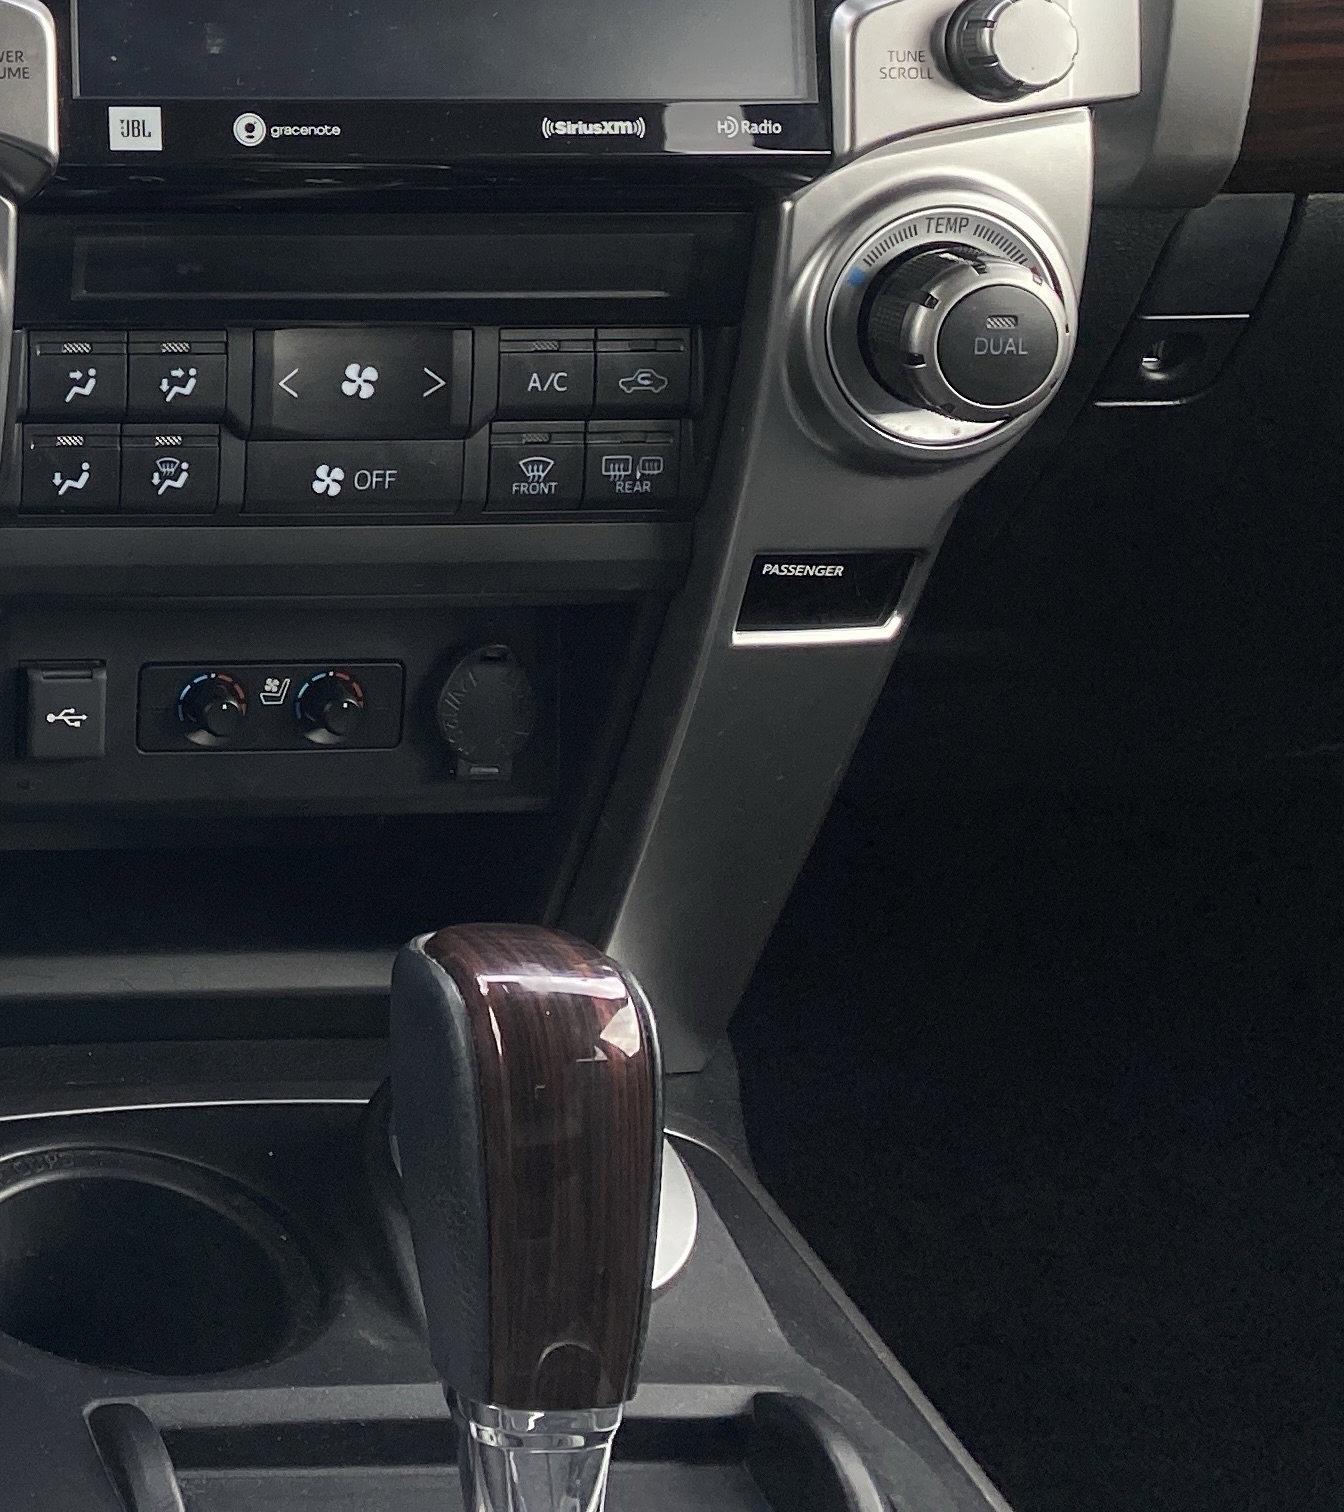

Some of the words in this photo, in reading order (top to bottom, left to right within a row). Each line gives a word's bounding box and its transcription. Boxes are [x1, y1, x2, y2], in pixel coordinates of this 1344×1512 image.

[887, 50, 926, 64] TUNE
[879, 65, 934, 81] SCROLL
[119, 118, 152, 138] JBL
[270, 122, 341, 138] gracenote
[740, 119, 782, 135] Radio
[925, 217, 970, 234] TEMP
[974, 336, 1028, 355] DUAL
[527, 372, 568, 392] A/C
[354, 470, 398, 491] OFF
[615, 480, 651, 494] REAR
[511, 482, 558, 496] FRONT
[762, 563, 844, 578] PASSENGER
